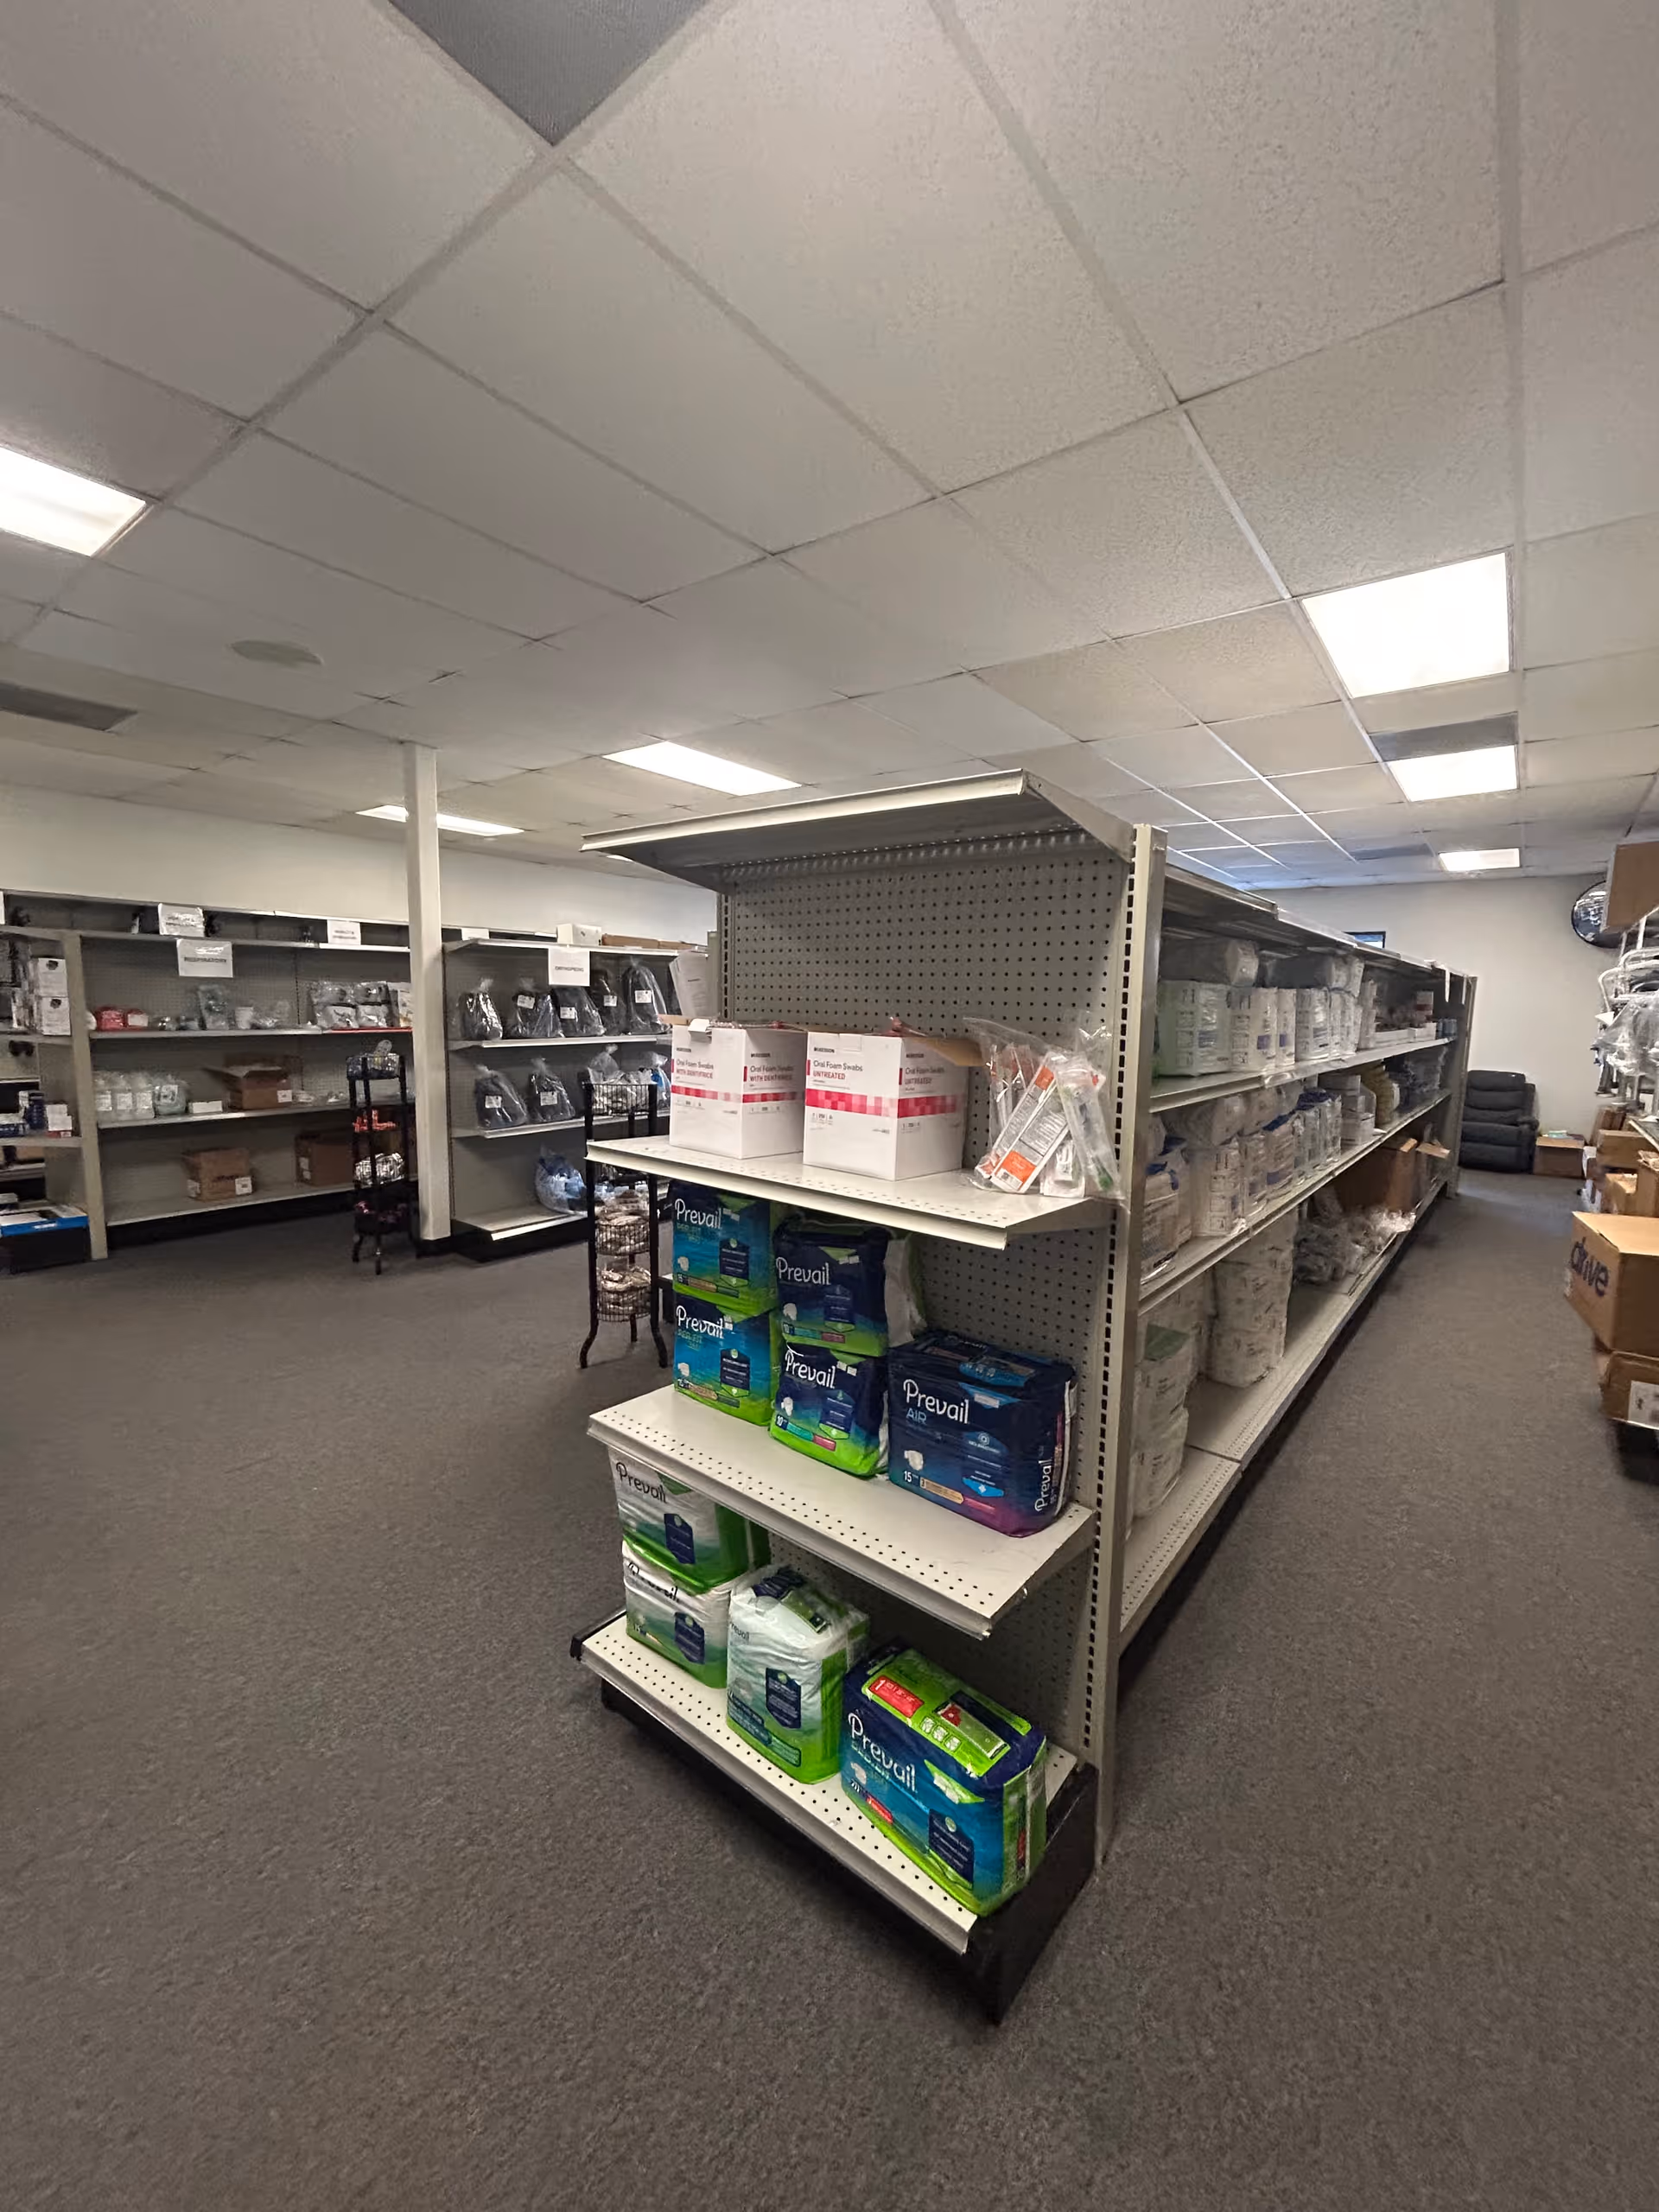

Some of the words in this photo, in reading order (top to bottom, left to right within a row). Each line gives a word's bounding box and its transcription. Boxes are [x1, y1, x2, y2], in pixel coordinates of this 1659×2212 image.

[813, 1059, 825, 1068] Oral
[826, 1061, 842, 1070] Foam
[843, 1063, 863, 1072] Swabs
[813, 1071, 846, 1080] UNTREATED
[675, 1198, 722, 1230] Prevail
[776, 1256, 831, 1285] Prevail
[1570, 1236, 1610, 1297] drive
[677, 1305, 724, 1339] Prevail
[785, 1350, 836, 1389] Prevail
[903, 1379, 969, 1424] Prevail
[906, 1408, 927, 1425] AIR
[616, 1461, 668, 1503] Prevail
[904, 1470, 912, 1483] 15
[1034, 1459, 1052, 1512] Prevail
[848, 1713, 918, 1792] Prevail
